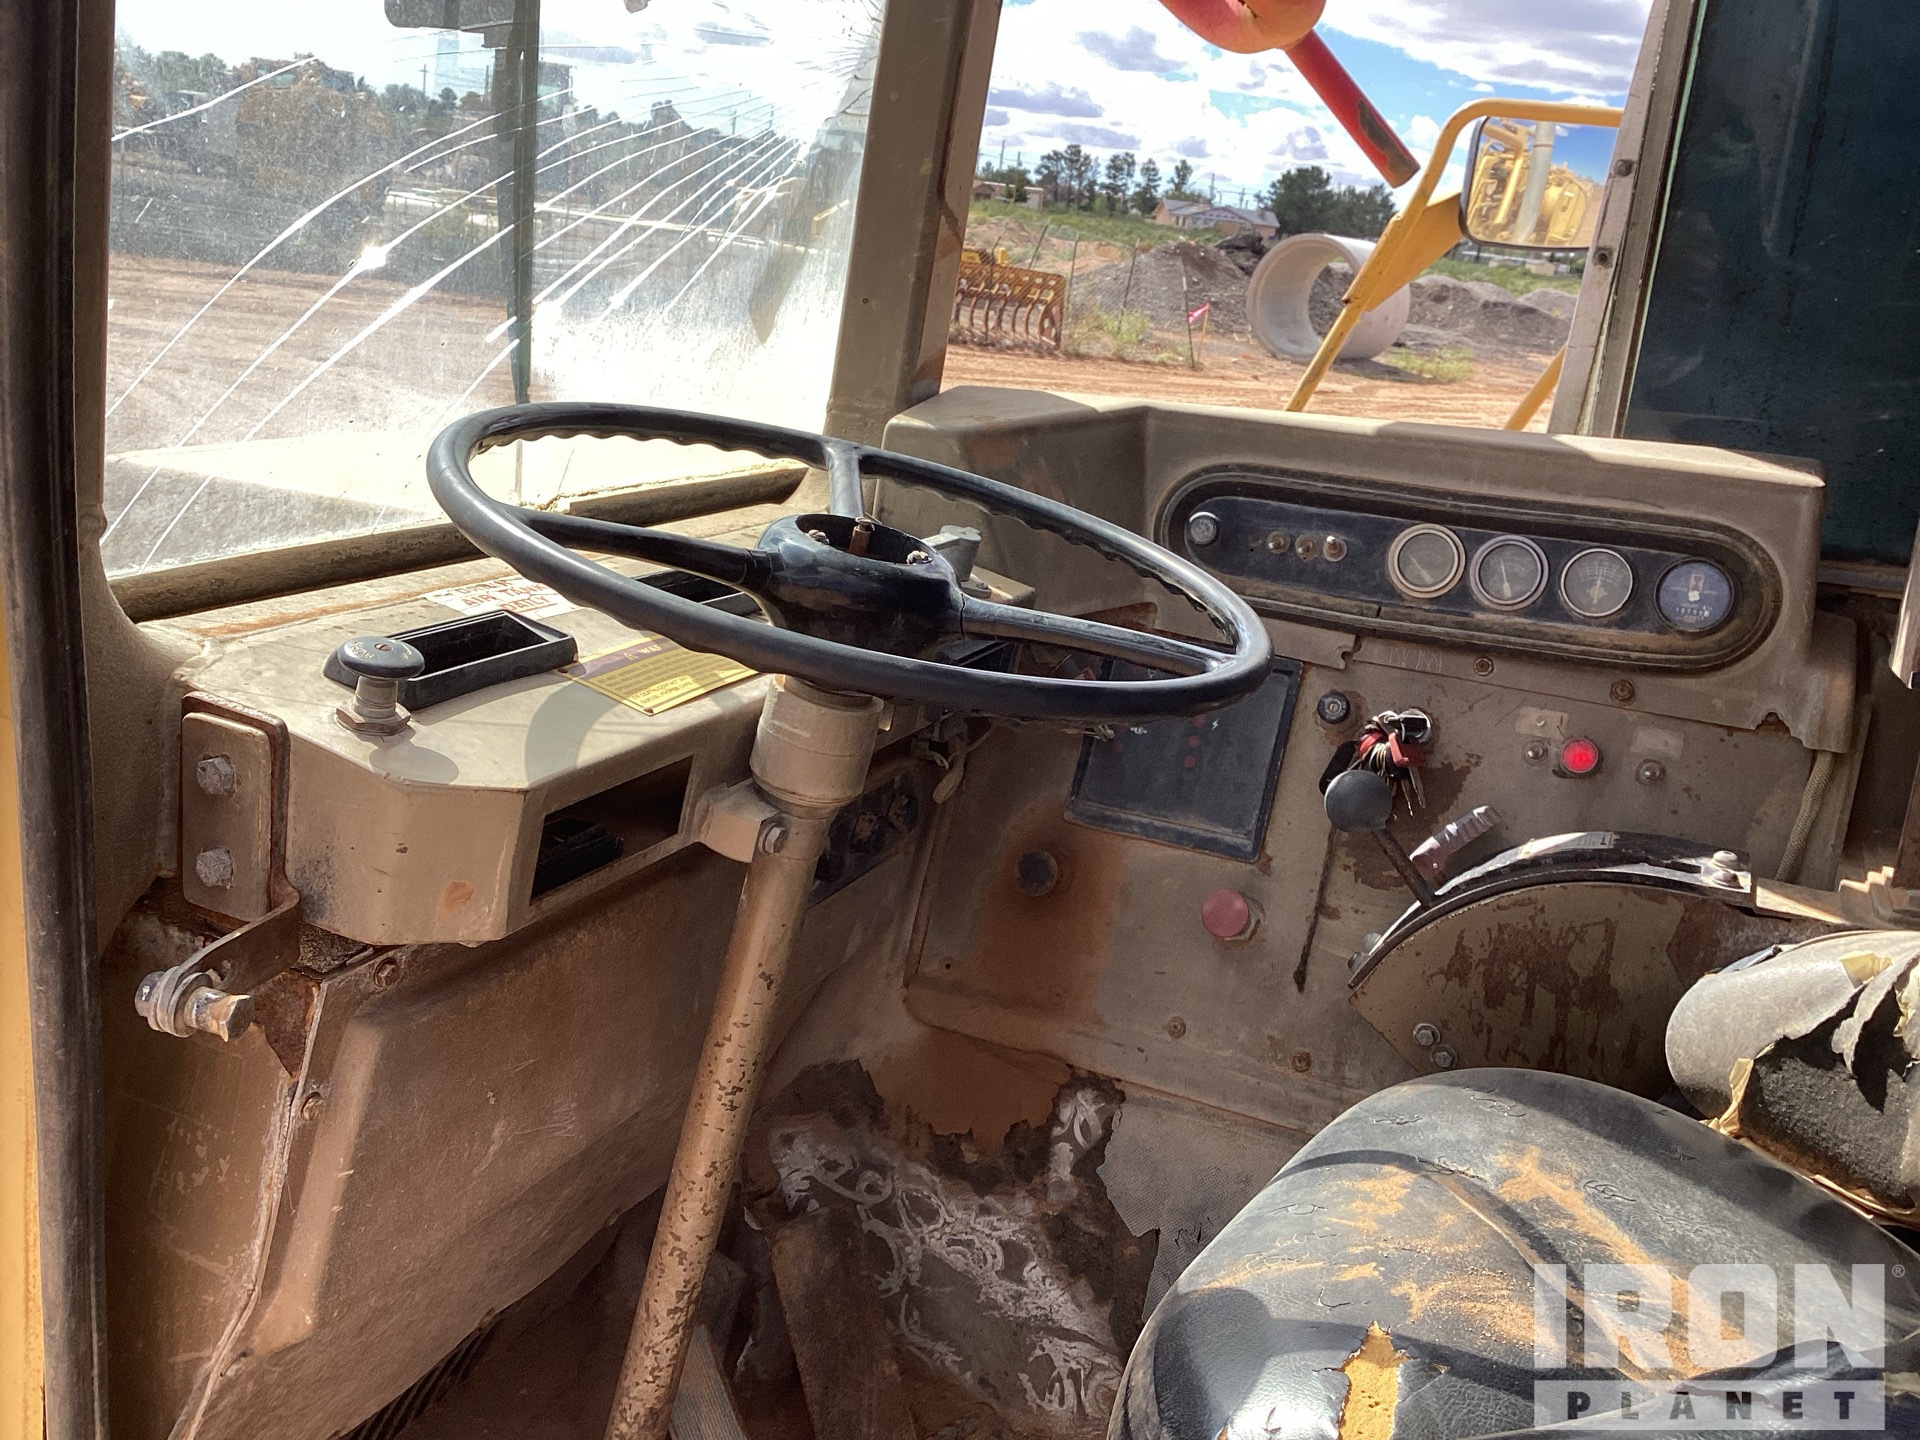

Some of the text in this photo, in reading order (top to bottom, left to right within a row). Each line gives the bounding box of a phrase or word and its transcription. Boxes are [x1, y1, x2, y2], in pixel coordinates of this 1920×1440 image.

[463, 582, 550, 606] AIR TANK
[499, 596, 551, 611] DAILY
